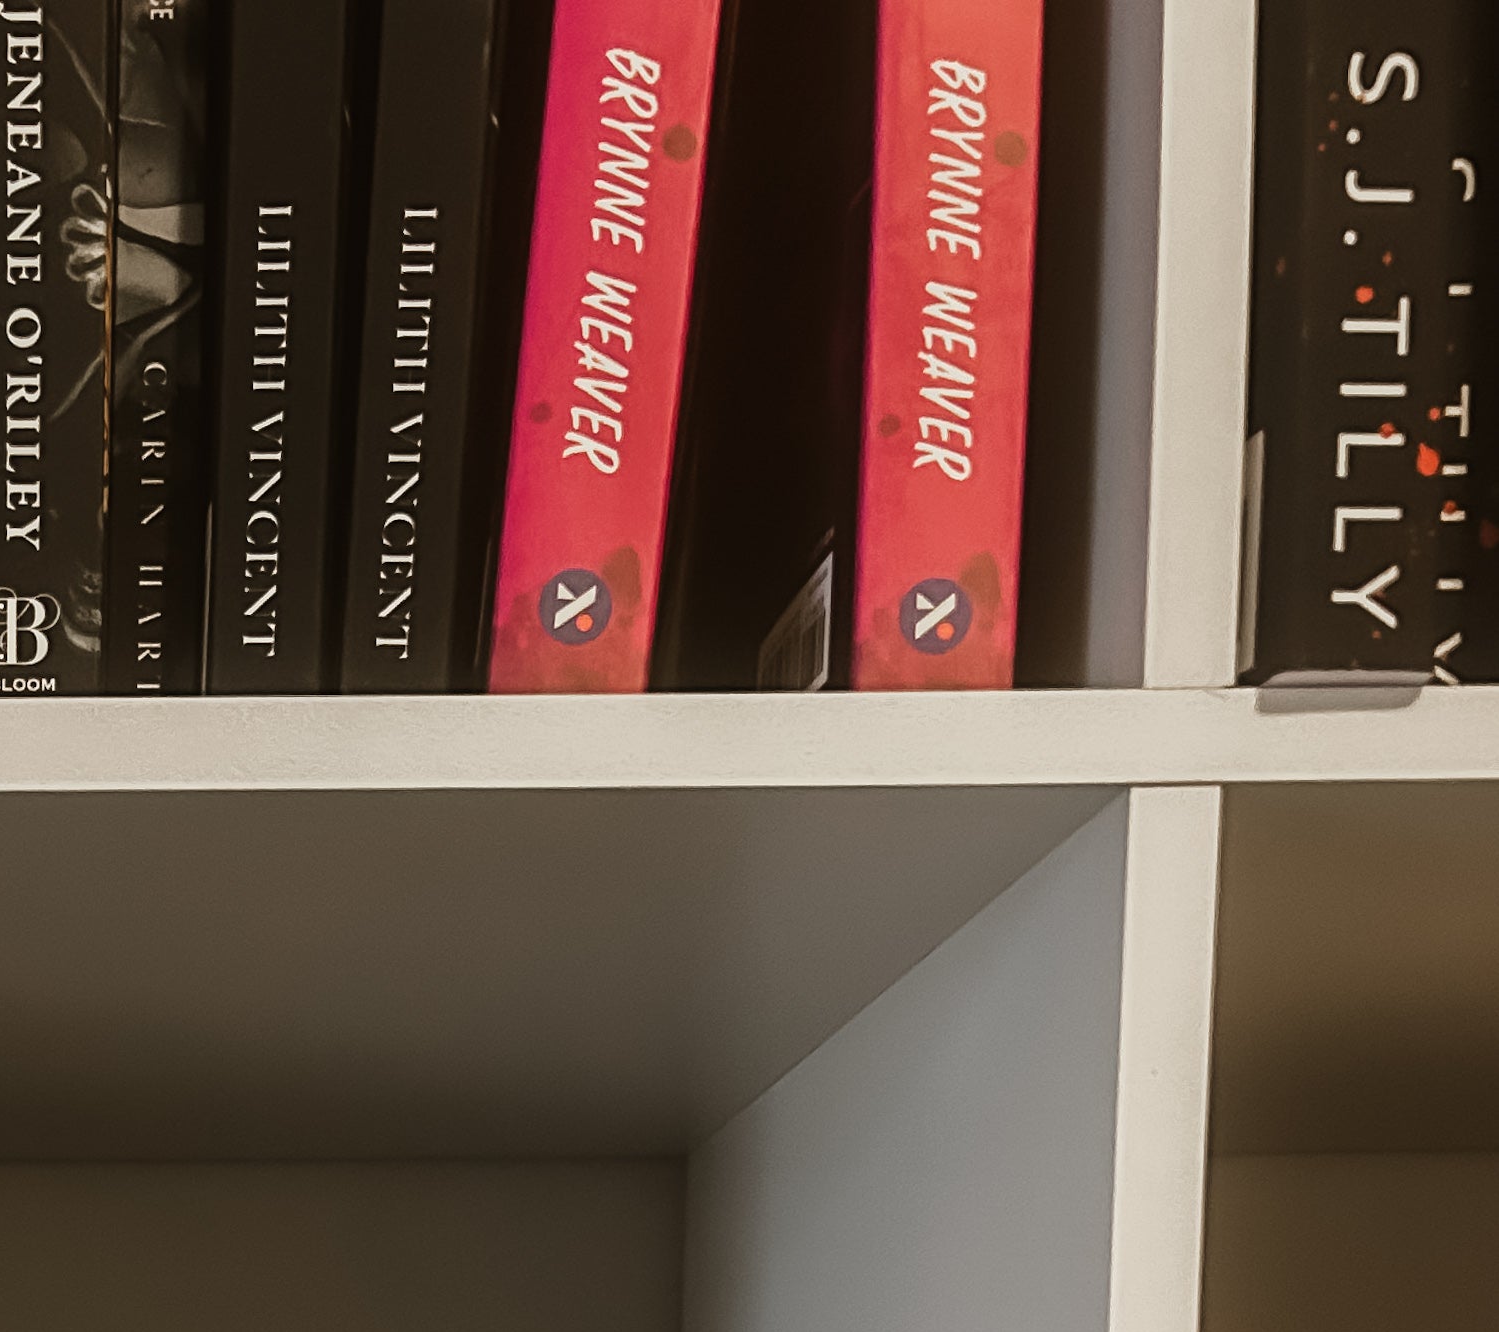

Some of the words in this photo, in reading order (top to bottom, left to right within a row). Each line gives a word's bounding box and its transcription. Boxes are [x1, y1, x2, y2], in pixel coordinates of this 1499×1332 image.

[589, 46, 662, 255] BRYNNE
[927, 59, 987, 260] BRYNNE
[252, 204, 293, 392] LILITH
[392, 206, 439, 394] LILITH
[561, 268, 638, 476] WEAVER
[912, 281, 979, 482] WEAVER
[5, 307, 42, 552] O'RILEY
[242, 409, 284, 657] VINCENT
[1331, 297, 1413, 629] TILLY
[375, 412, 424, 660] VINCENT
